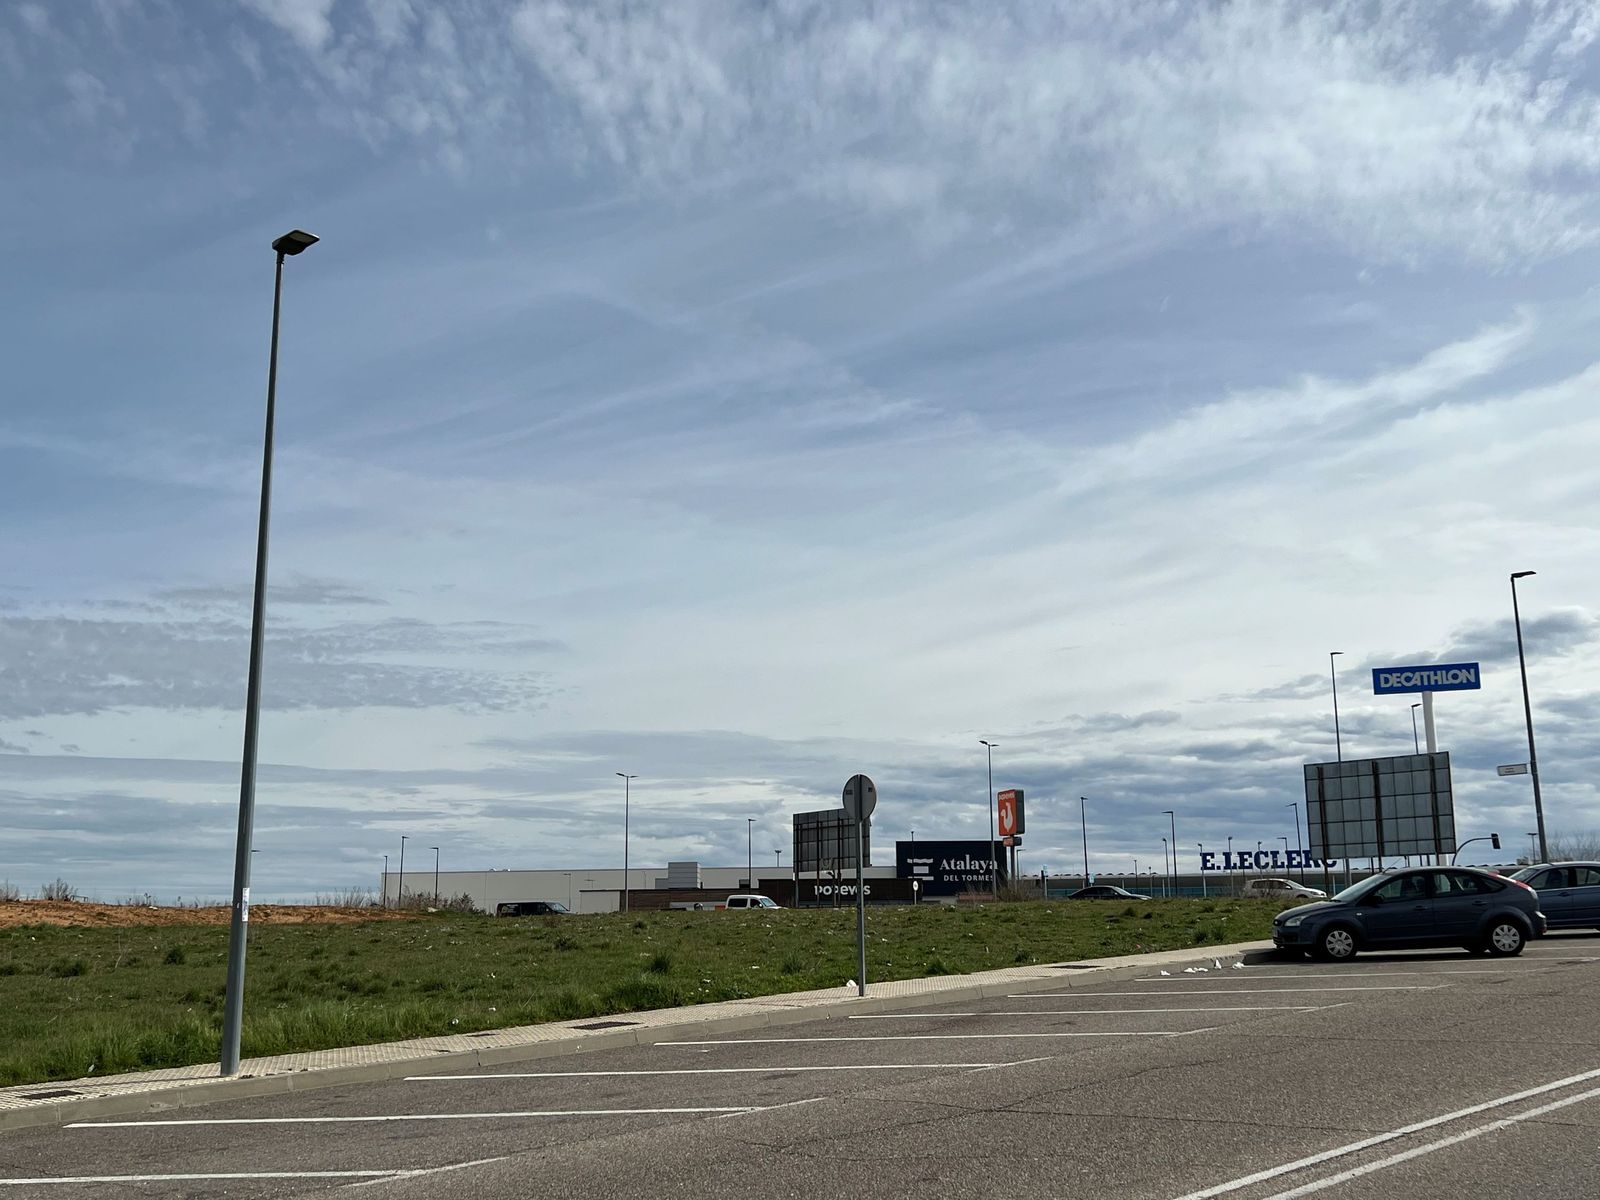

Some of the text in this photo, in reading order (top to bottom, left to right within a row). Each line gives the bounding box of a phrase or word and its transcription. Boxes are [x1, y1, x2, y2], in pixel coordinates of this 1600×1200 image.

[1380, 668, 1476, 688] DECATHLON
[939, 854, 999, 874] Atalaya
[943, 874, 960, 882] DEL
